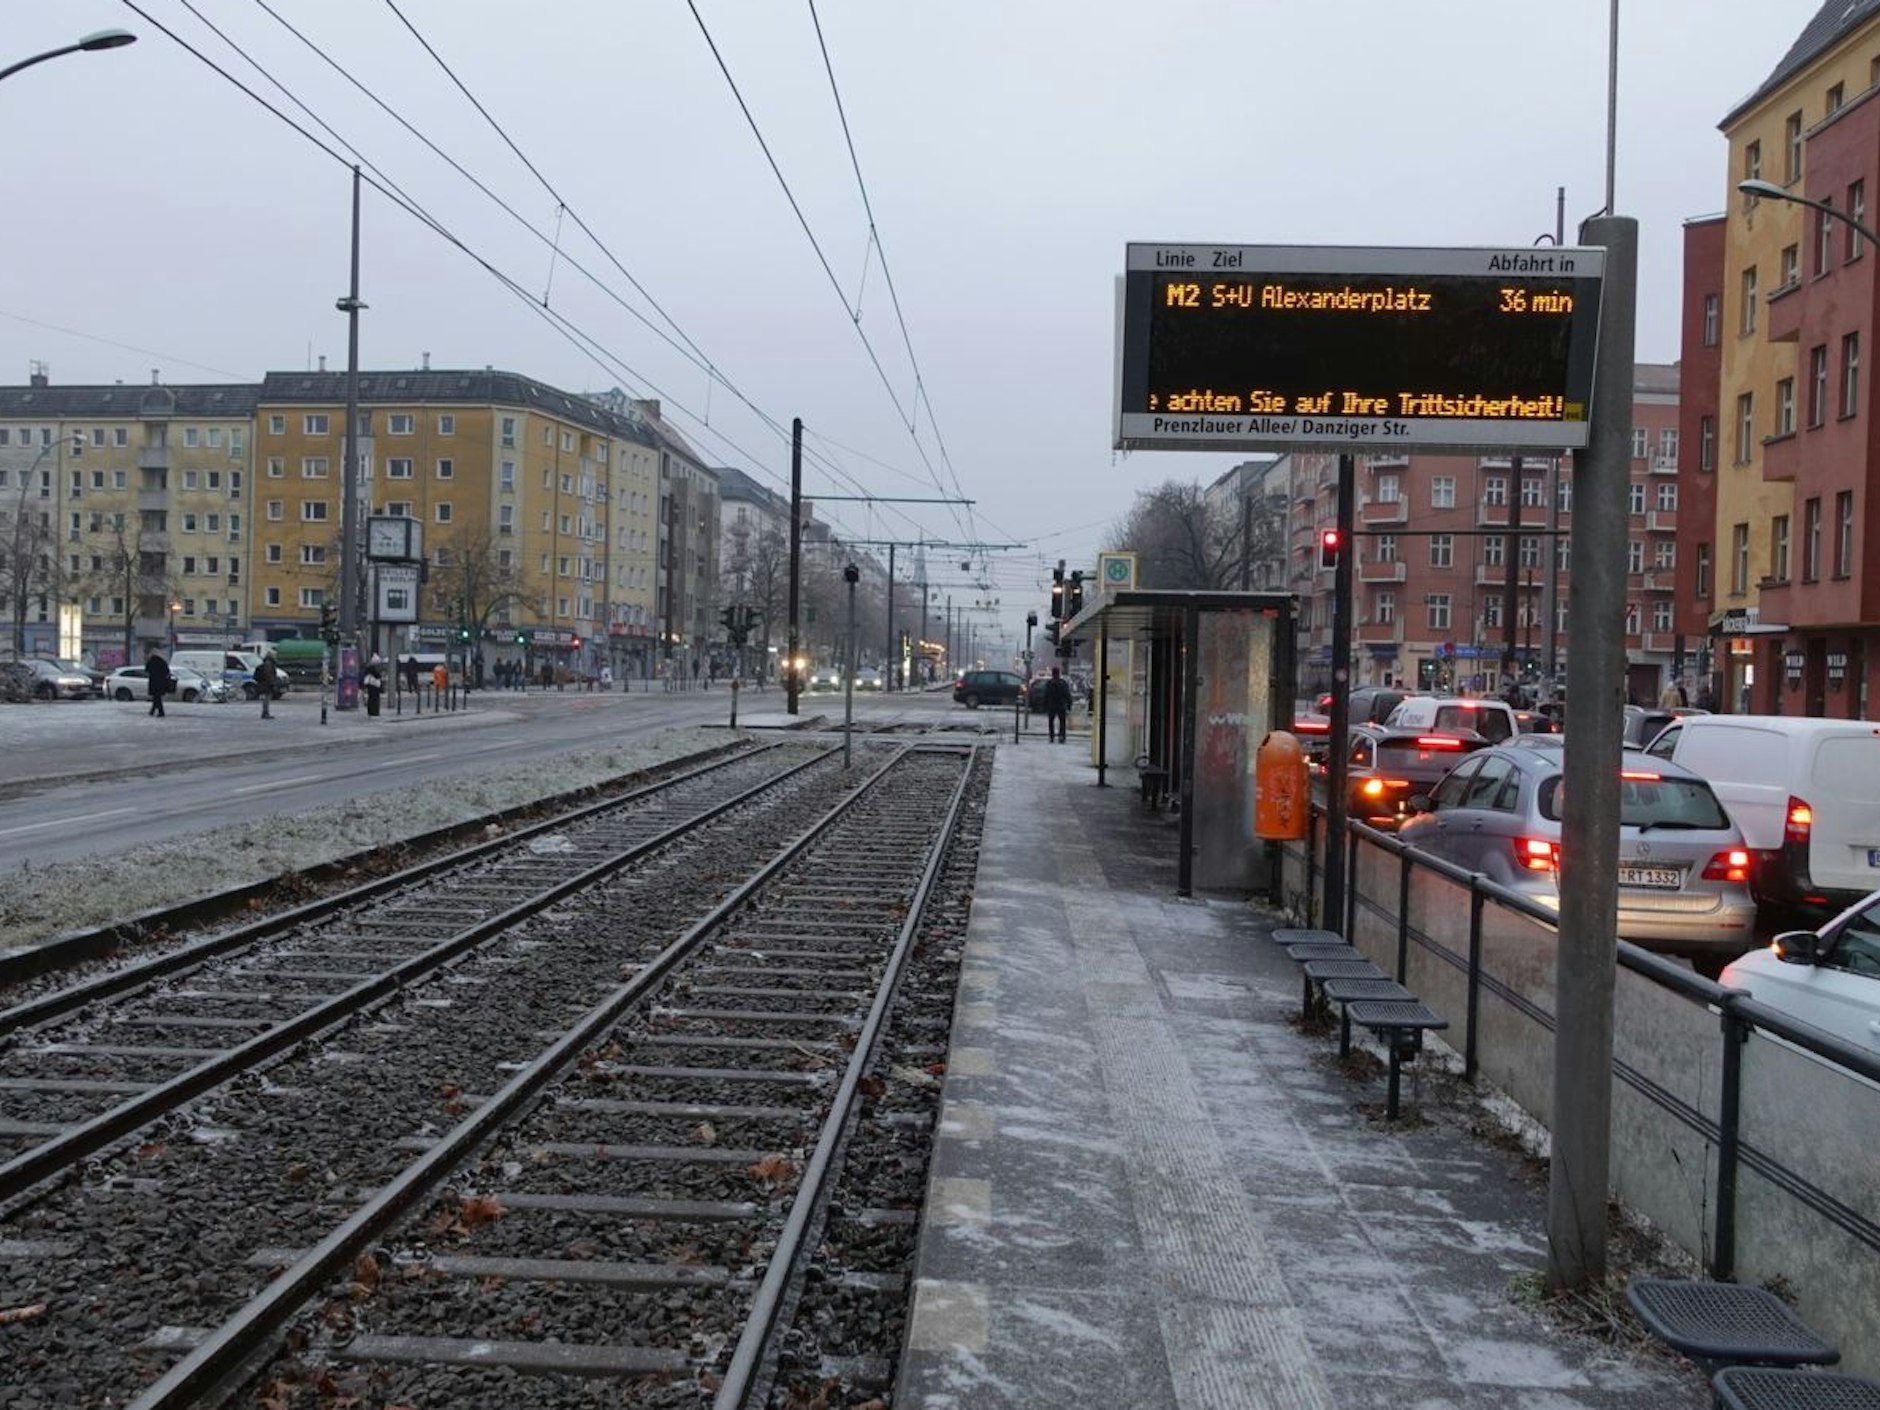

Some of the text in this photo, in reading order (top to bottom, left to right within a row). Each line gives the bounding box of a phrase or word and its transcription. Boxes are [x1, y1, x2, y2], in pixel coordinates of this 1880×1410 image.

[1156, 251, 1243, 268] Linie Ziel
[1488, 254, 1575, 273] Abfahrt in
[1167, 284, 1432, 313] M2 S+U Alexanderplatz
[1500, 289, 1573, 313] 36 min
[1167, 389, 1242, 412] achten
[1250, 390, 1286, 413] Sie
[1295, 391, 1334, 414] auf
[1342, 391, 1389, 415] Ihre
[1398, 392, 1563, 418] Trittsicherheit!
[1154, 417, 1410, 438] Prenzlauer Allee/ Danziger Str.
[1646, 871, 1678, 885] 1332
